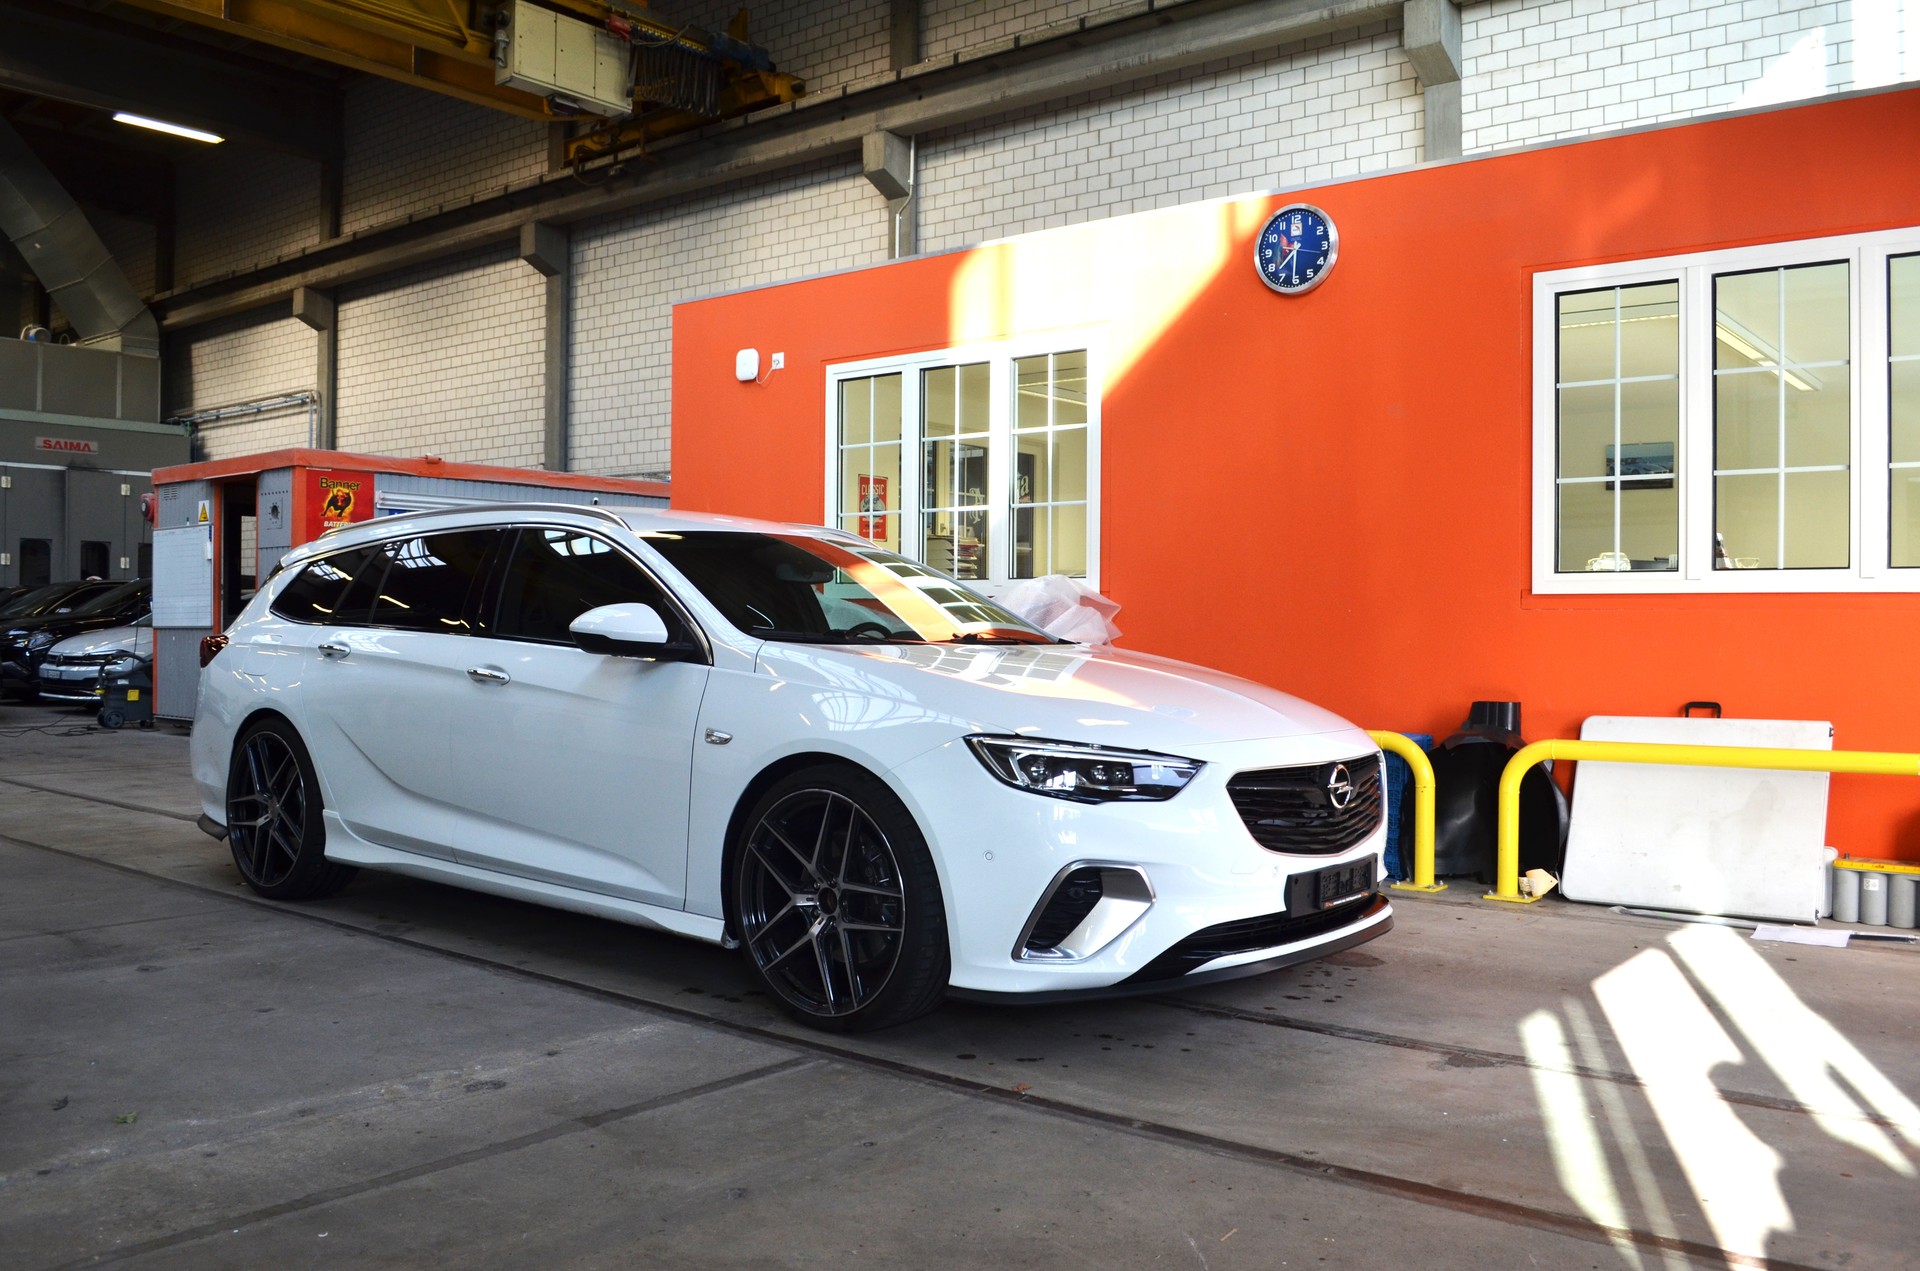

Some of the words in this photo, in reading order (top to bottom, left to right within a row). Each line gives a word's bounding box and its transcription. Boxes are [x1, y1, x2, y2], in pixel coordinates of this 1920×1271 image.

[1291, 215, 1301, 224] 12
[1308, 216, 1312, 225] 1
[1280, 221, 1286, 230] 11
[1316, 226, 1324, 235] 2
[1269, 234, 1278, 243] 10
[1321, 241, 1328, 250] 3
[1265, 249, 1272, 258] 9
[1316, 257, 1324, 265] 4
[1268, 263, 1276, 272] 8
[1279, 273, 1286, 282] 7
[1306, 269, 1314, 278] 5
[1292, 275, 1299, 284] 6
[42, 439, 92, 452] SAIMA
[320, 478, 361, 491] Banner
